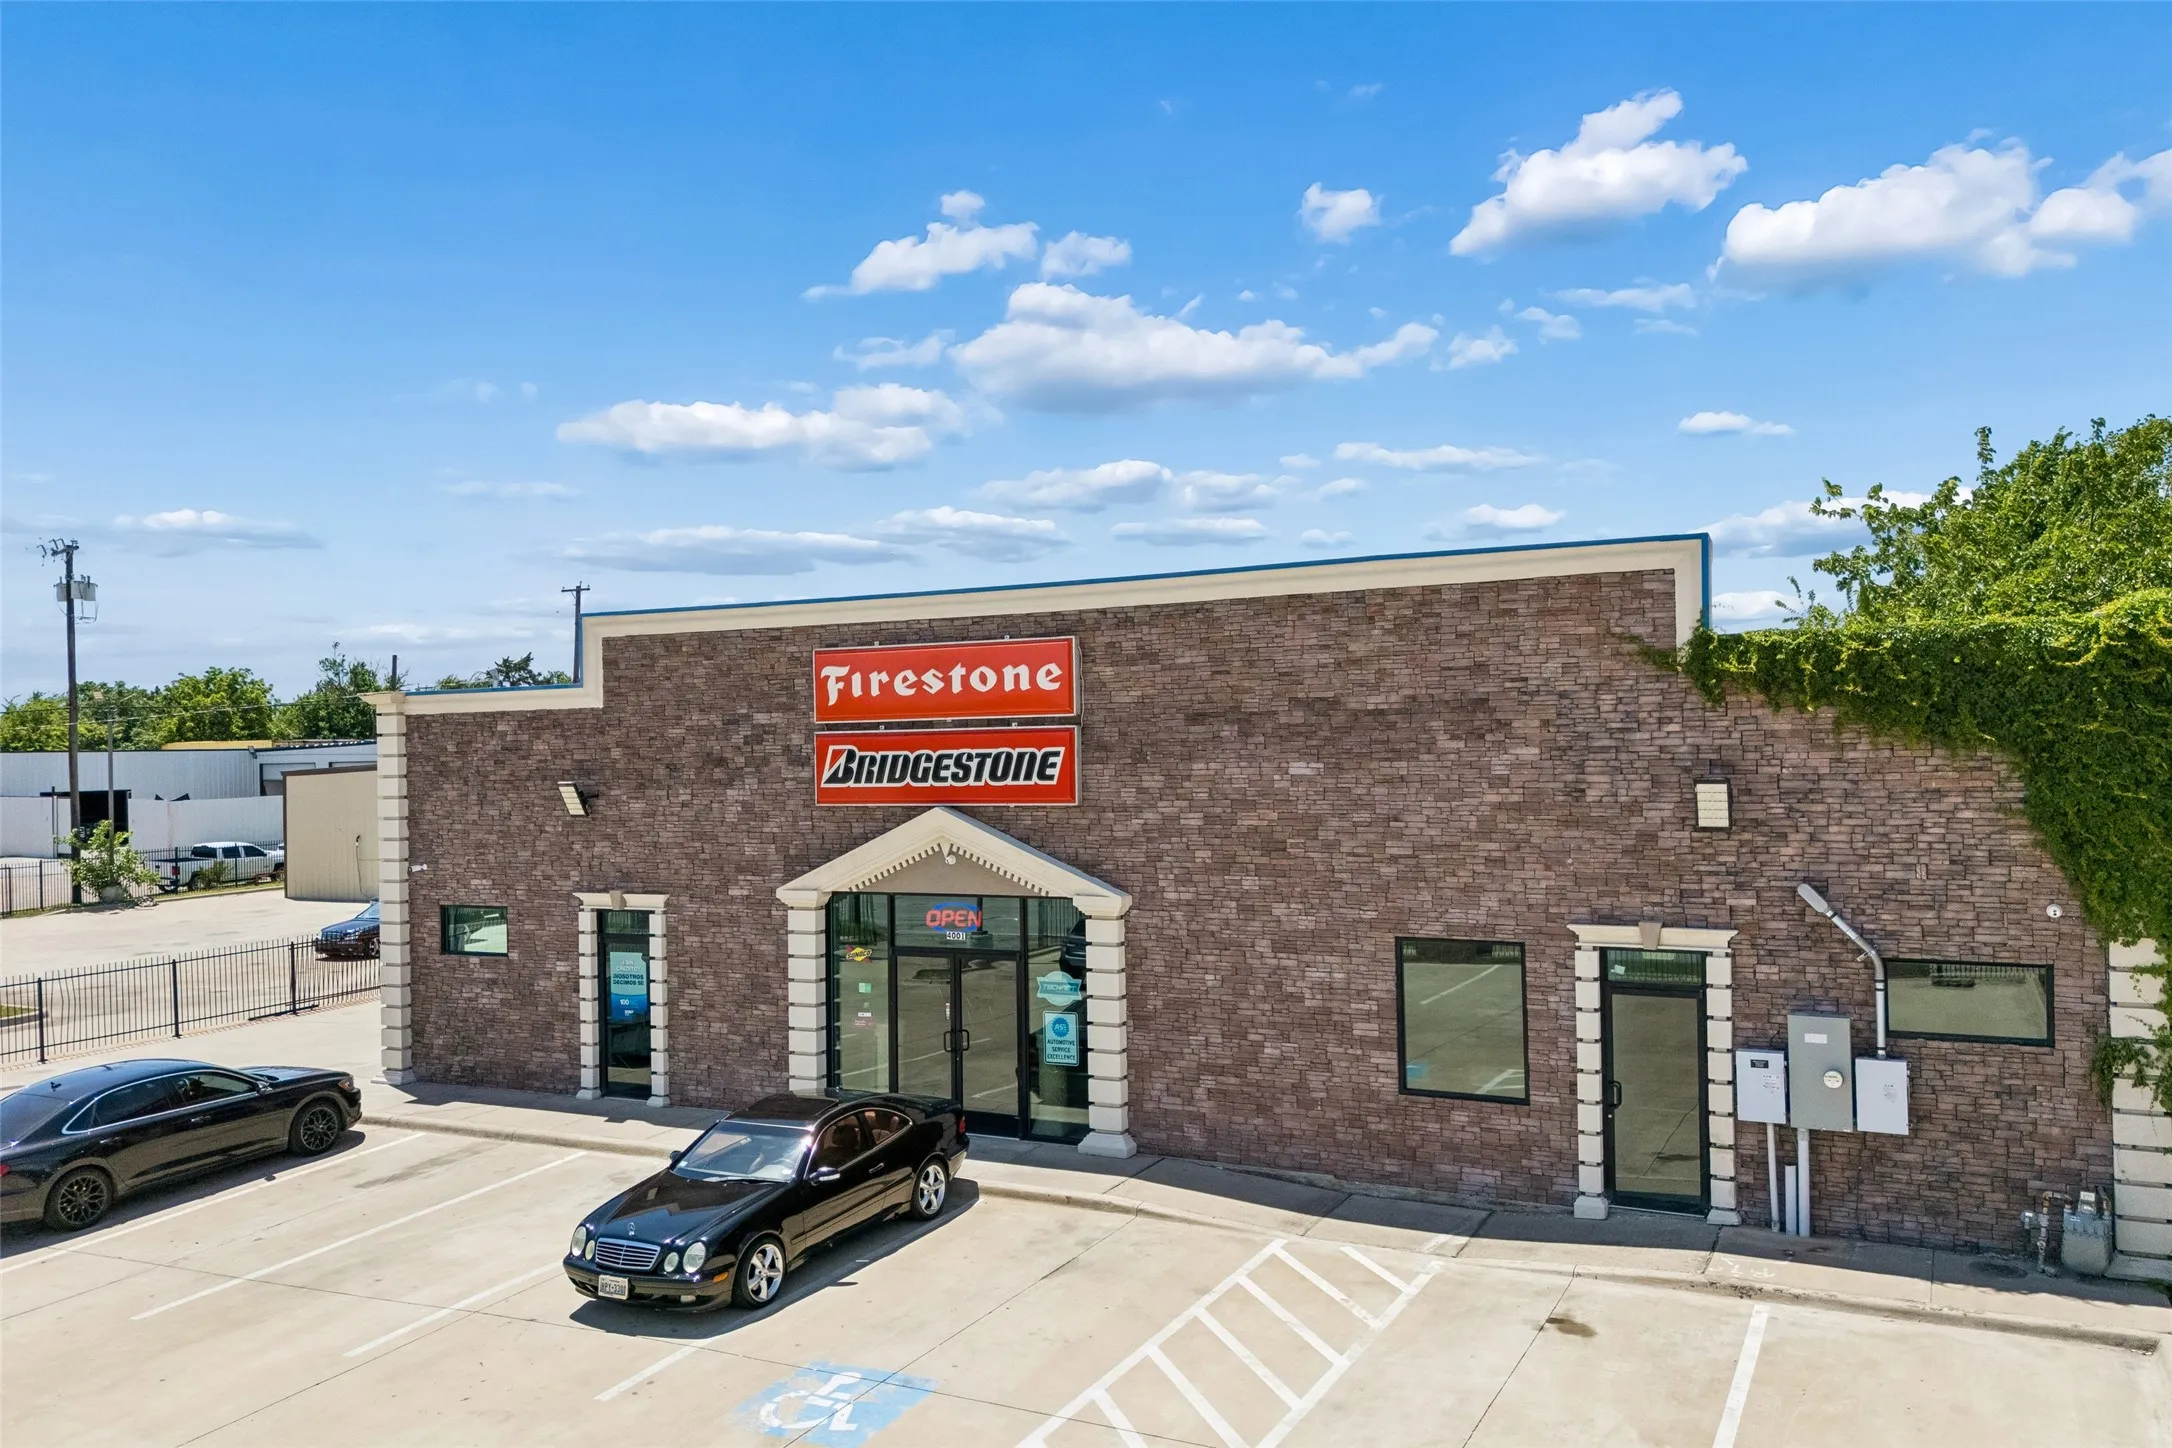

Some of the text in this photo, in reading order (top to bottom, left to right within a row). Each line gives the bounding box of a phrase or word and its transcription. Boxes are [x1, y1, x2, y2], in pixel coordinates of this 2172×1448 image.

[820, 662, 1063, 706] Firestone
[821, 745, 1065, 787] BRIDGESTONE
[925, 909, 982, 928] OPEN
[947, 931, 965, 940] 4001
[1054, 1023, 1067, 1031] ASE
[1047, 1038, 1076, 1047] AUTOMOTIVE
[1047, 1053, 1076, 1061] EXCELLENCE
